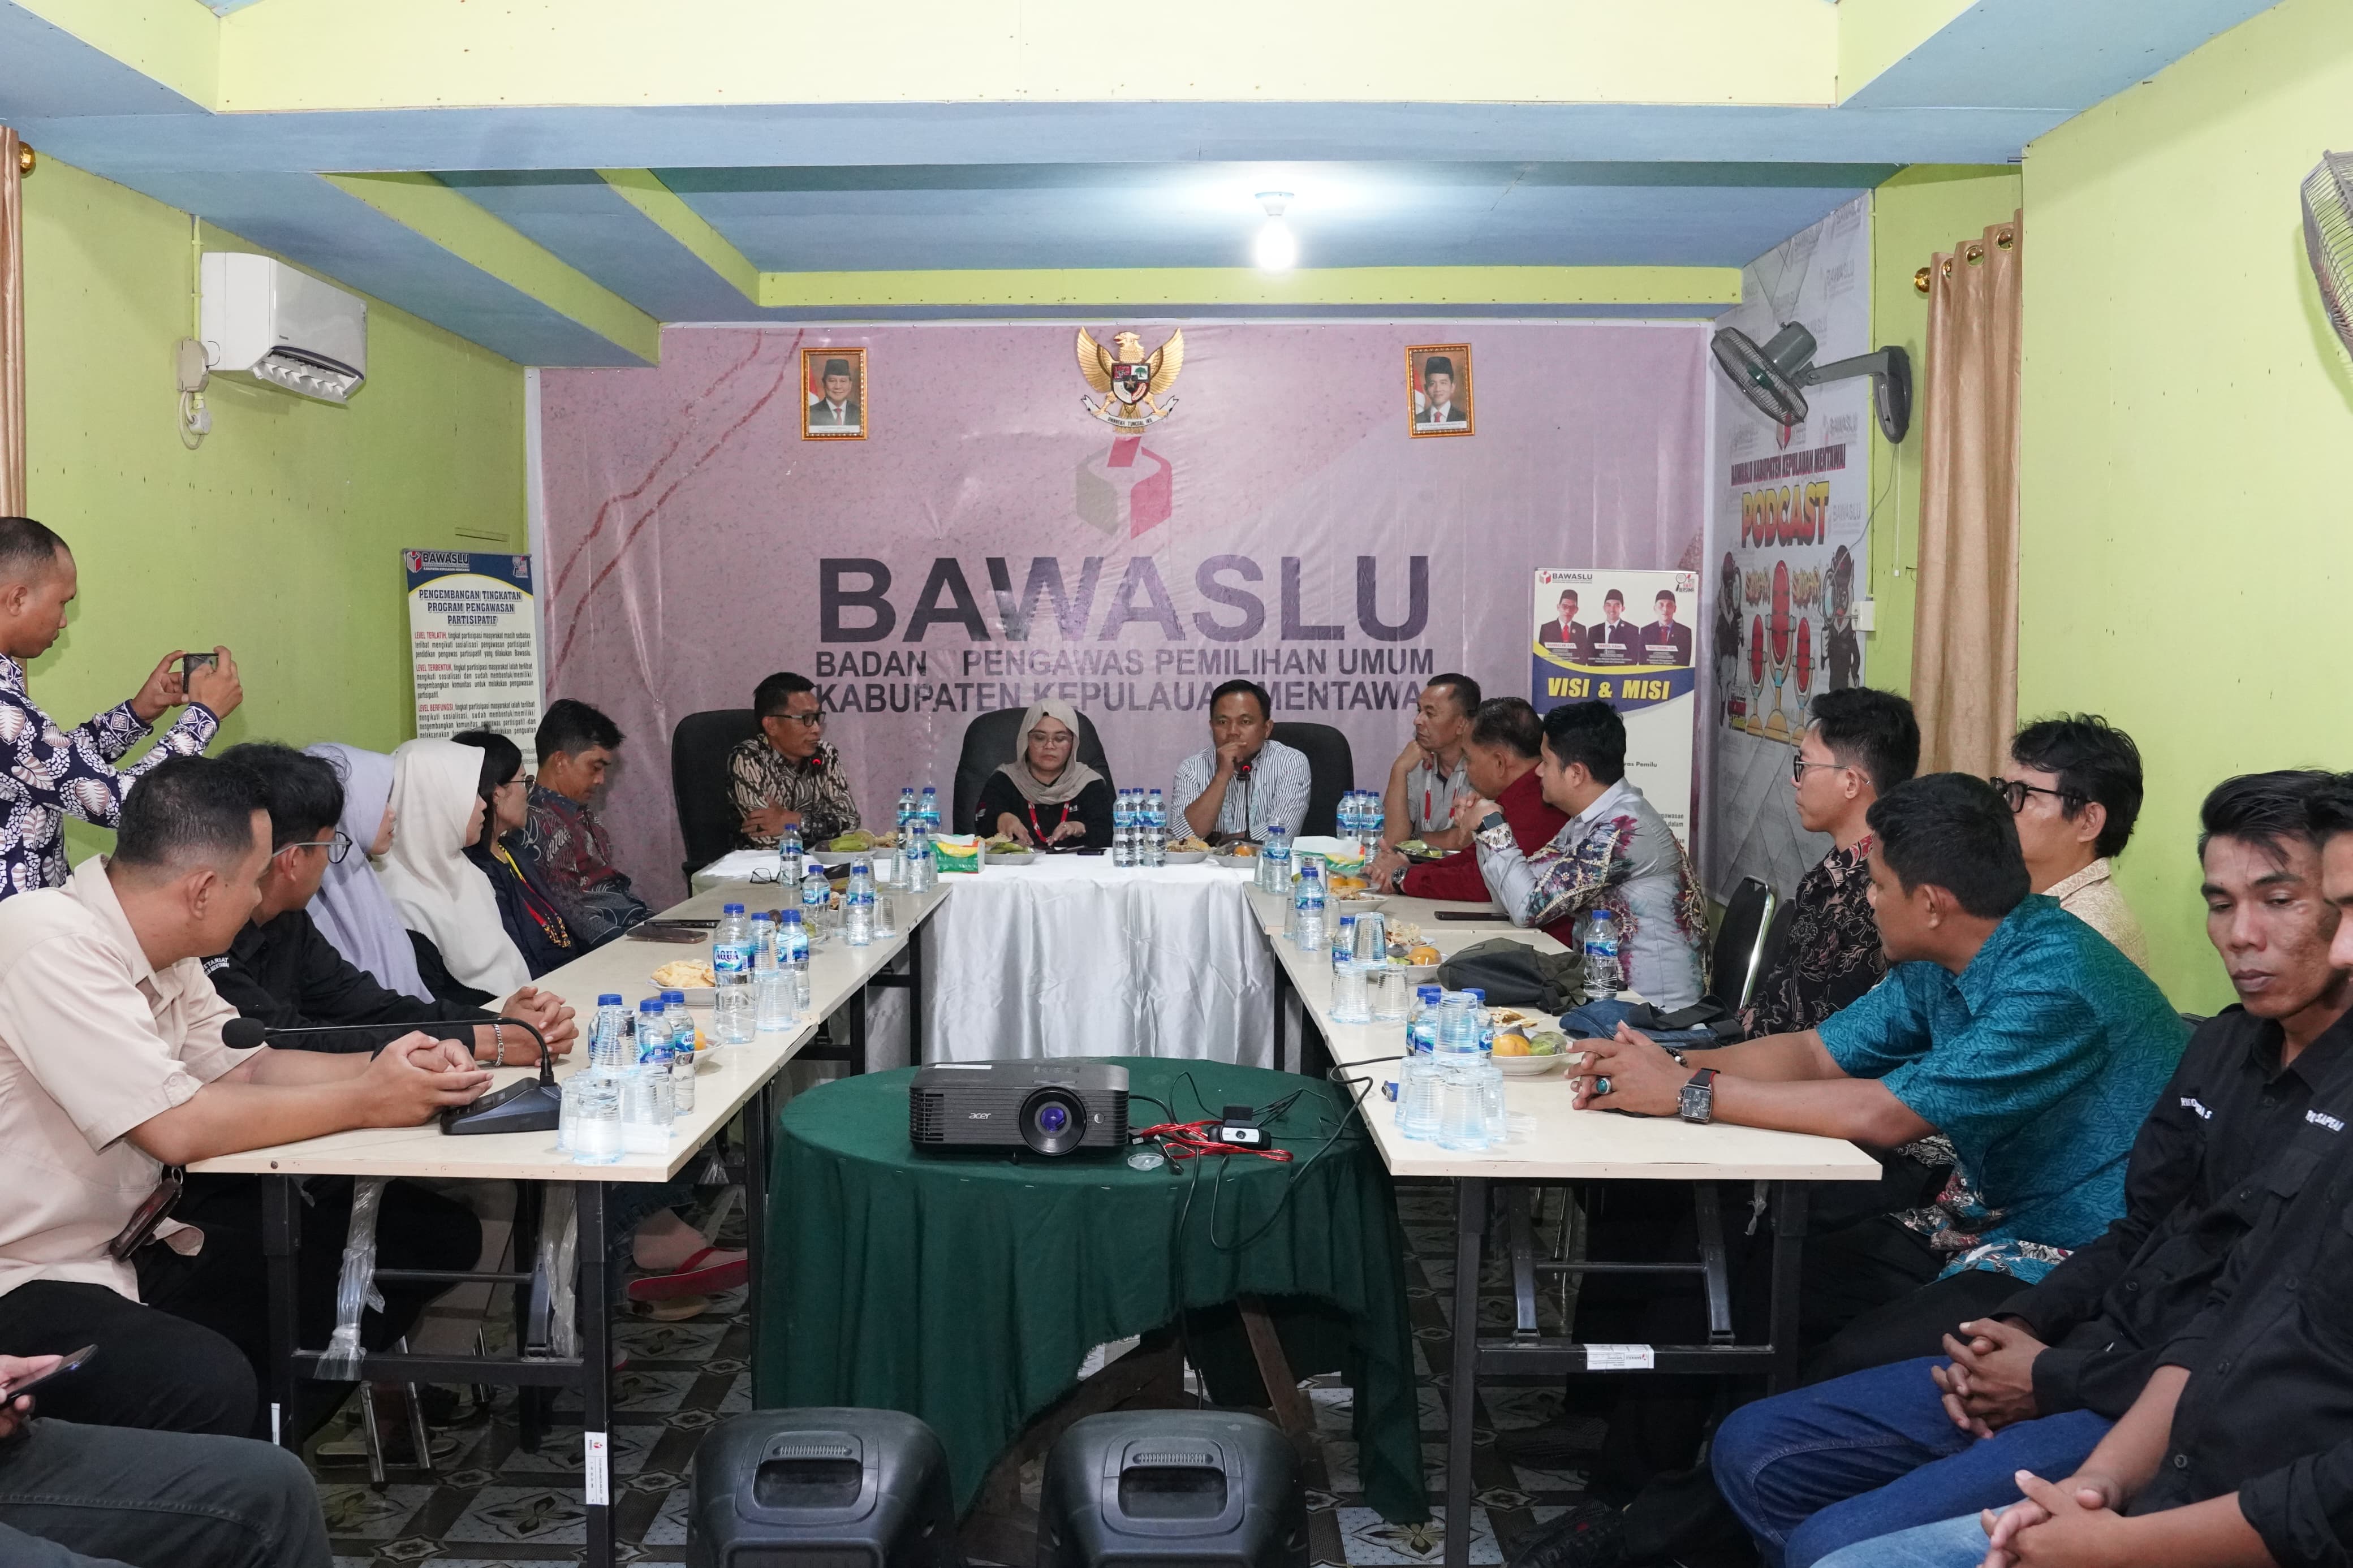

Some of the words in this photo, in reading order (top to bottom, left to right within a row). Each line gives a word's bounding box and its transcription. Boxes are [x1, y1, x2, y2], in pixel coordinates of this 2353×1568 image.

[1742, 481, 1829, 548] PODCAST
[423, 553, 469, 563] BAWASLU
[419, 590, 480, 599] PENGEMBANGAN
[482, 591, 521, 600] TINGKATAN
[819, 555, 1428, 642] BAWASLU
[428, 603, 463, 611] PROGRAM
[466, 603, 514, 612] PENGAWASAN
[448, 616, 497, 624] PARTISIPATIF
[816, 651, 926, 677] BADAN
[964, 649, 1144, 676] PENGAWAS
[1156, 649, 1327, 675] PEMILIHAN
[1338, 648, 1433, 675] UMUM
[1547, 677, 1591, 697] VISI
[1598, 681, 1613, 699] &
[1622, 680, 1670, 700] MISI
[817, 682, 1019, 713] KABUPATEN
[1034, 681, 1212, 711] KEPULAUA
[1262, 681, 1421, 710] MENTAWA
[469, 703, 489, 711] partisipasi
[420, 723, 454, 731] mengembangkan
[715, 950, 739, 962] AQUA
[204, 957, 229, 969] ETARIAT
[684, 1034, 695, 1043] AQU
